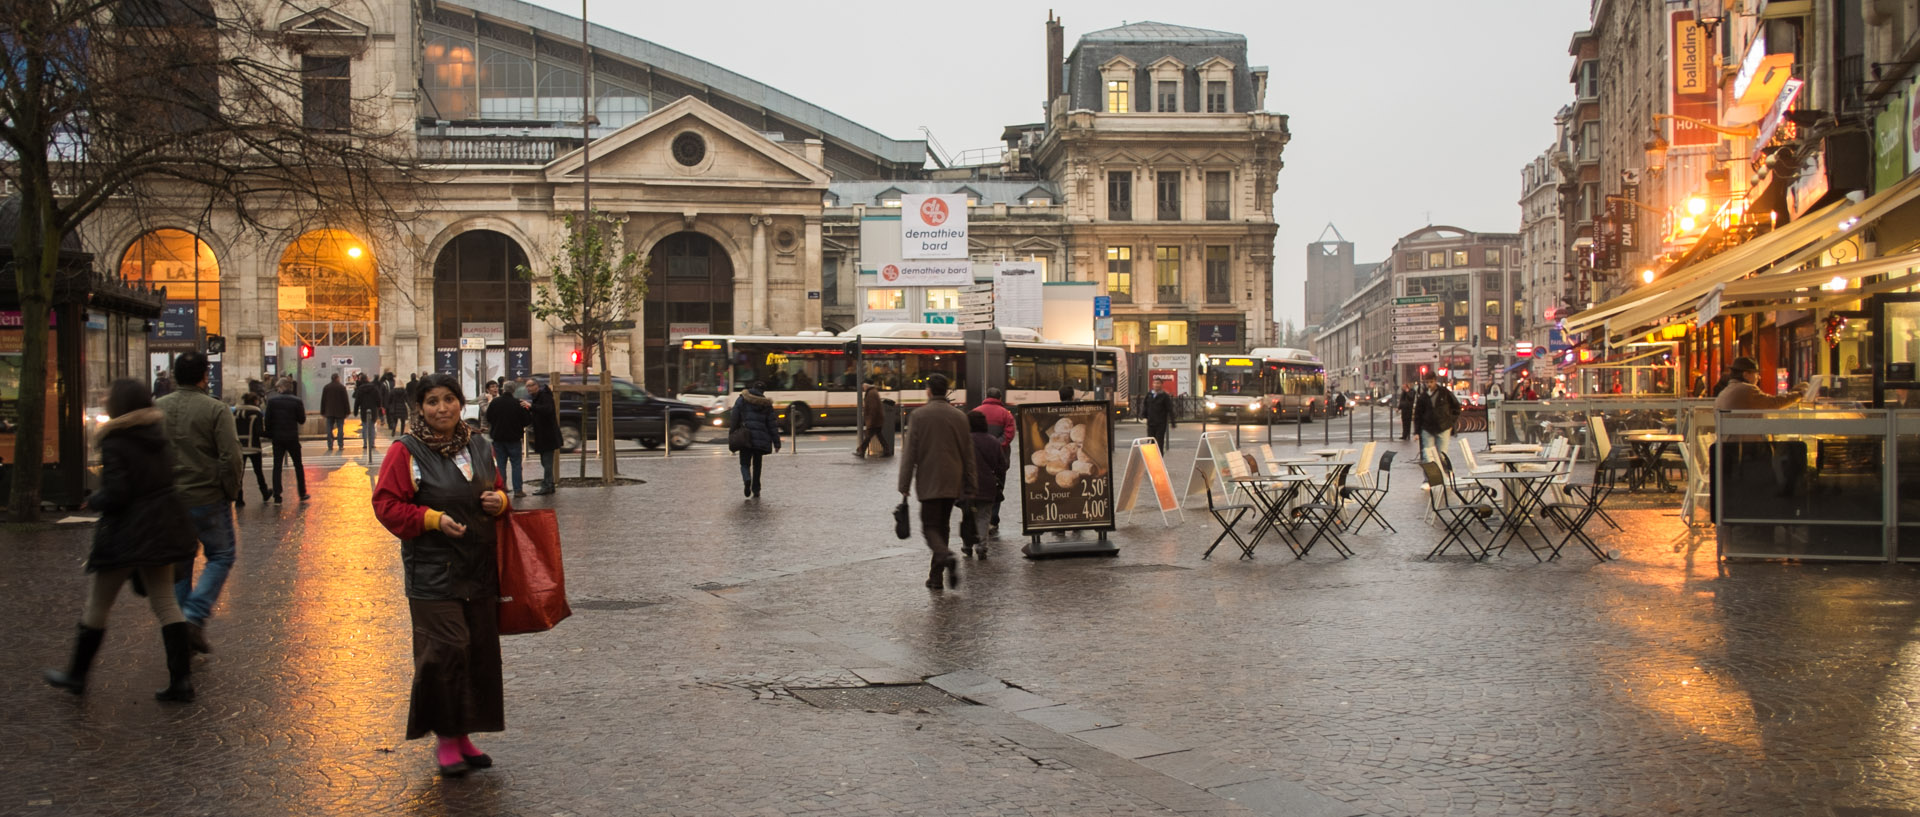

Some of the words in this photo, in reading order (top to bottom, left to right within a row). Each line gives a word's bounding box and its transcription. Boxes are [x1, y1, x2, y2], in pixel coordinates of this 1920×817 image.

[1683, 25, 1696, 88] balladins
[905, 229, 965, 239] demathieu
[1622, 223, 1632, 246] DLM
[922, 241, 948, 250] bard
[901, 267, 946, 275] demathieu
[947, 266, 968, 274] bard
[1059, 405, 1075, 413] mini
[1076, 404, 1103, 412] beignets
[1030, 491, 1043, 500] Les
[1044, 481, 1050, 500] 5
[1051, 491, 1071, 501] pour
[1031, 513, 1044, 521] Les
[1045, 502, 1058, 521] 10
[1059, 513, 1078, 523] pour
